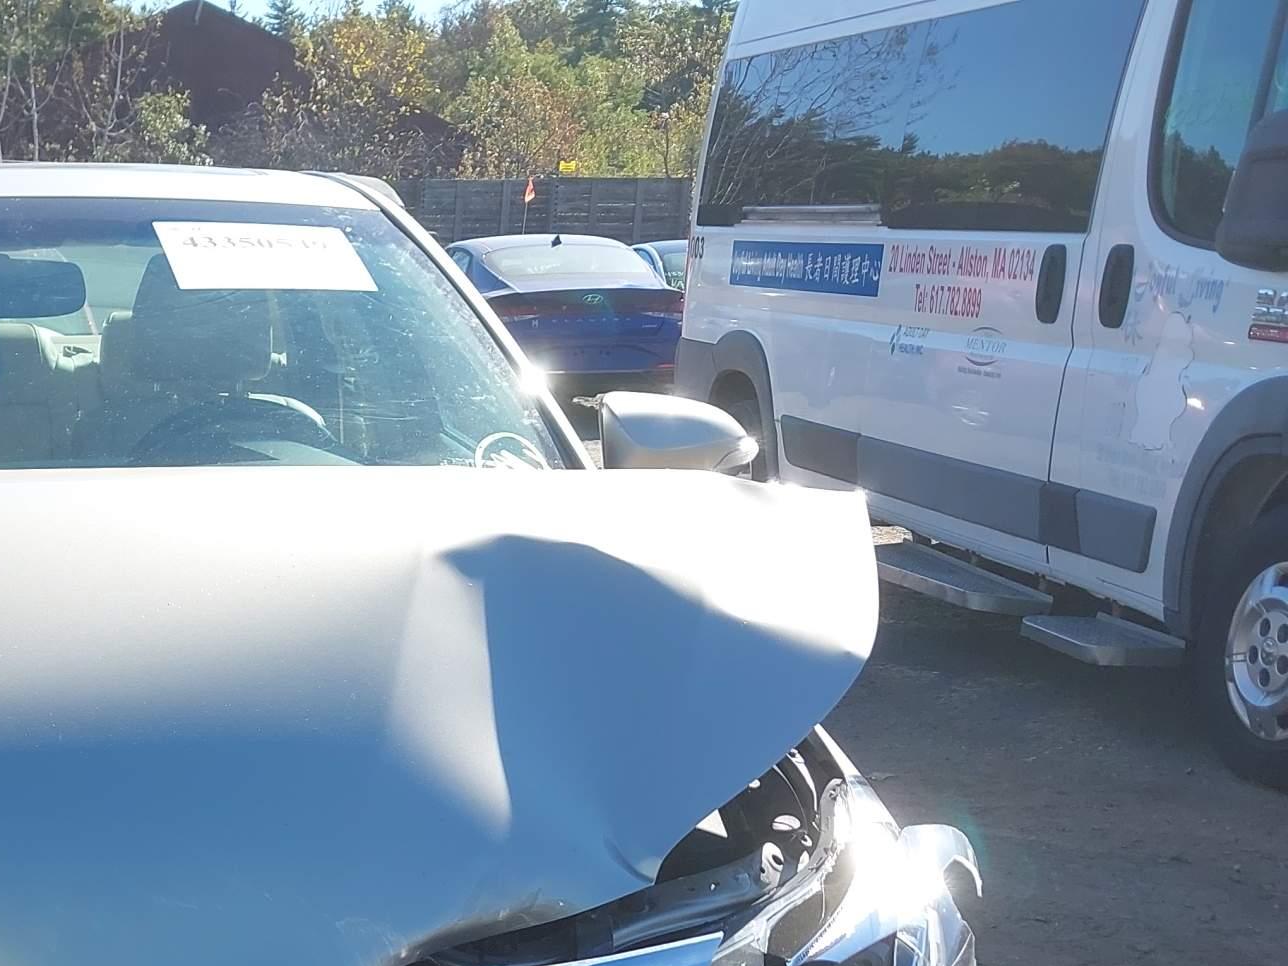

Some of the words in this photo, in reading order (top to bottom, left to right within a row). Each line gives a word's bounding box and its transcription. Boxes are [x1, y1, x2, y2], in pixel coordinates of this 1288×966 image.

[889, 246, 899, 273] 20
[899, 245, 926, 274] Linden
[926, 246, 951, 276] Street
[957, 246, 989, 283] Allston,
[991, 248, 1006, 280] MA
[1008, 249, 1036, 282] 02134
[914, 284, 927, 313] Tel:
[929, 285, 982, 319] 617.782.8899
